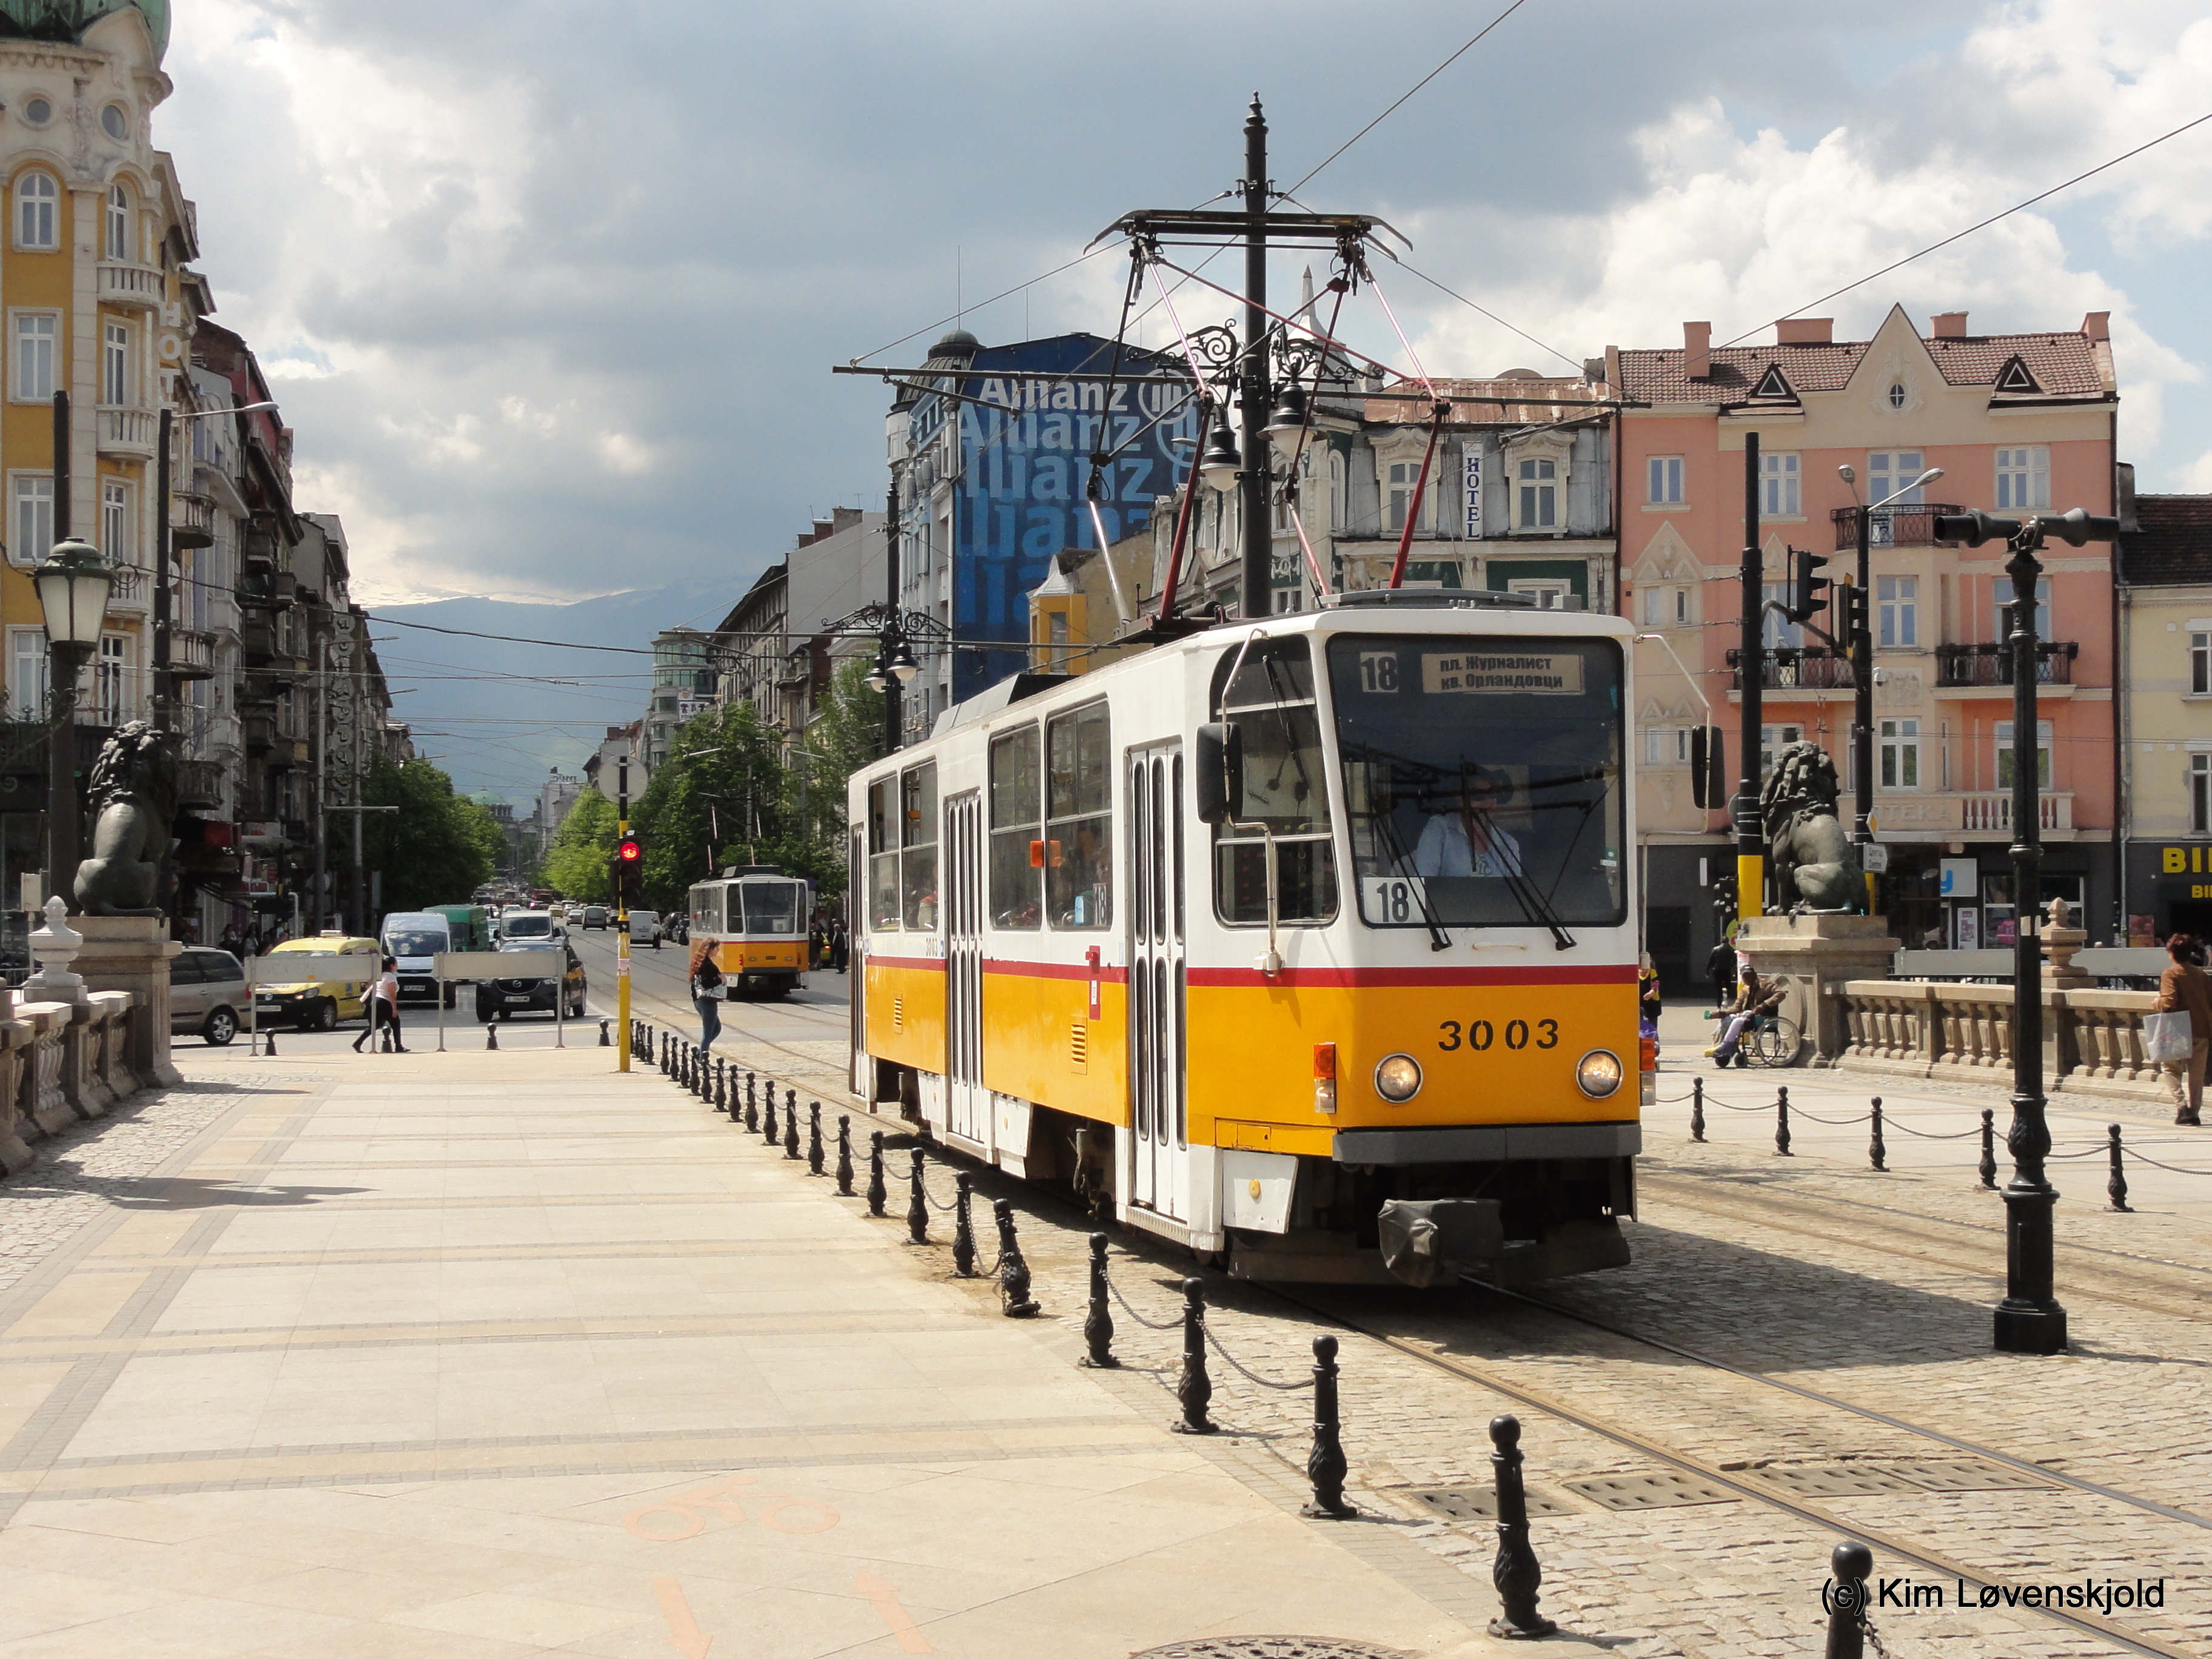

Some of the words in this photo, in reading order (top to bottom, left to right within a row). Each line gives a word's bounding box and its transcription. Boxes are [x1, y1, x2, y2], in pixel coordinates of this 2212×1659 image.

[978, 377, 1128, 411] Allianz
[959, 401, 1141, 451] Allianz
[1466, 457, 1480, 538] HOTEL
[1361, 656, 1397, 691] 18
[1439, 658, 1463, 672] пл.
[1466, 655, 1552, 671] Журналист
[1441, 677, 1463, 690] кв.
[1466, 673, 1563, 689] Орландовци
[1094, 885, 1107, 924] 18
[1376, 882, 1410, 922] 18
[1438, 1018, 1559, 1051] 3003
